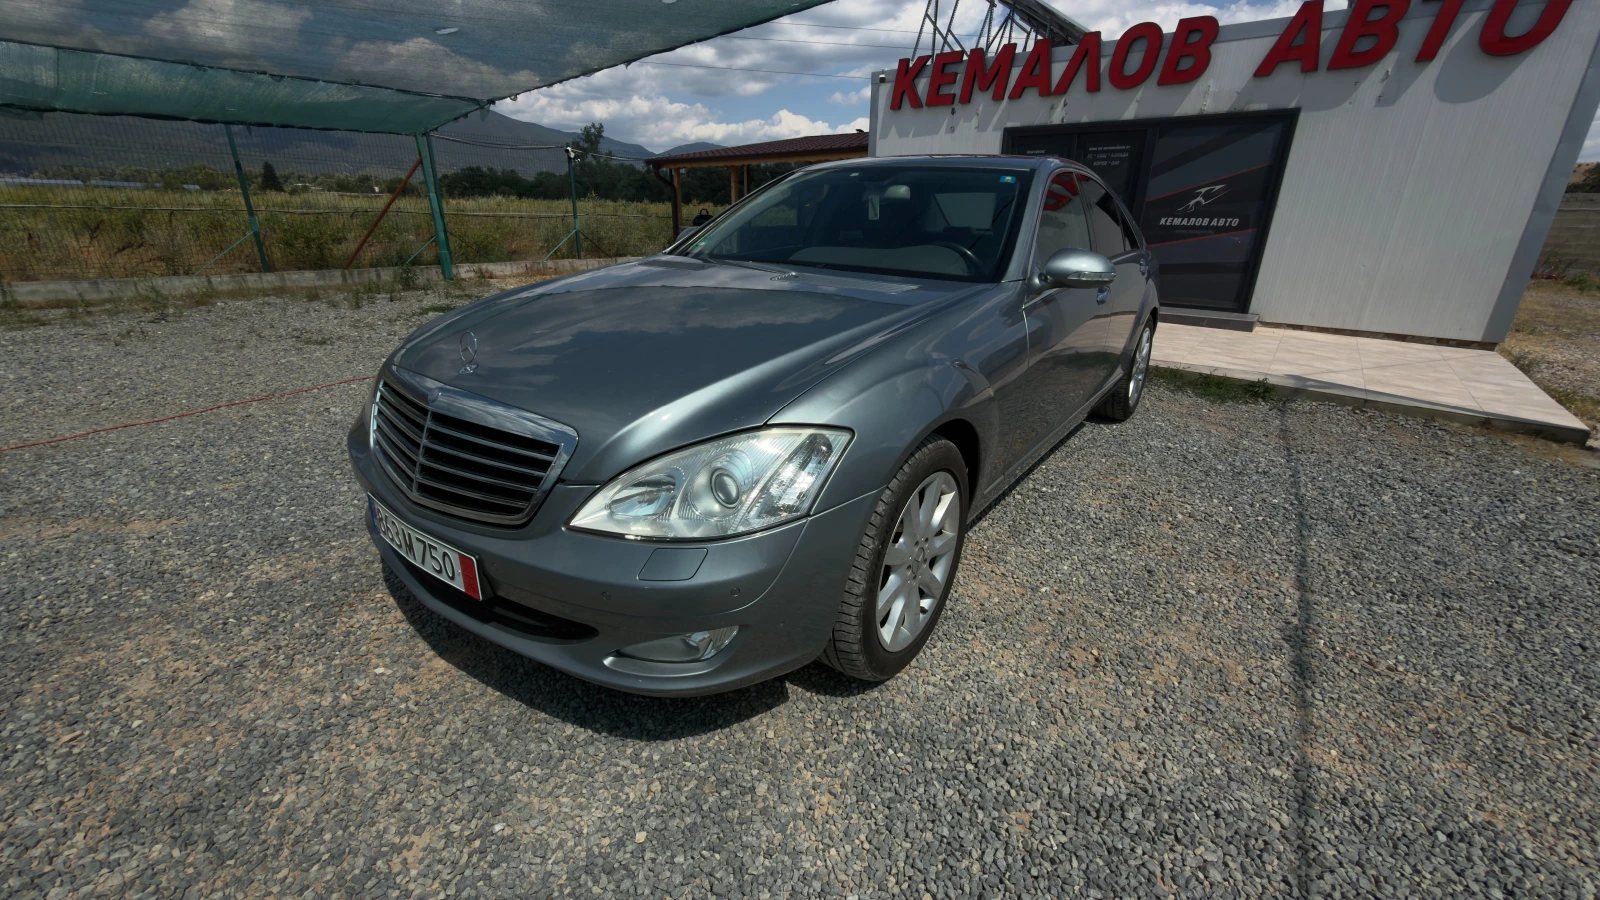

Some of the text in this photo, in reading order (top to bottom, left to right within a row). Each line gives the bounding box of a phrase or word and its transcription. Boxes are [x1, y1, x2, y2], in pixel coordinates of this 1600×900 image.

[890, 0, 1573, 111] КЕМАЛОВ АВТО
[1159, 217, 1239, 227] КЕМАЛОВ АВТО
[377, 506, 456, 581] 863M750
